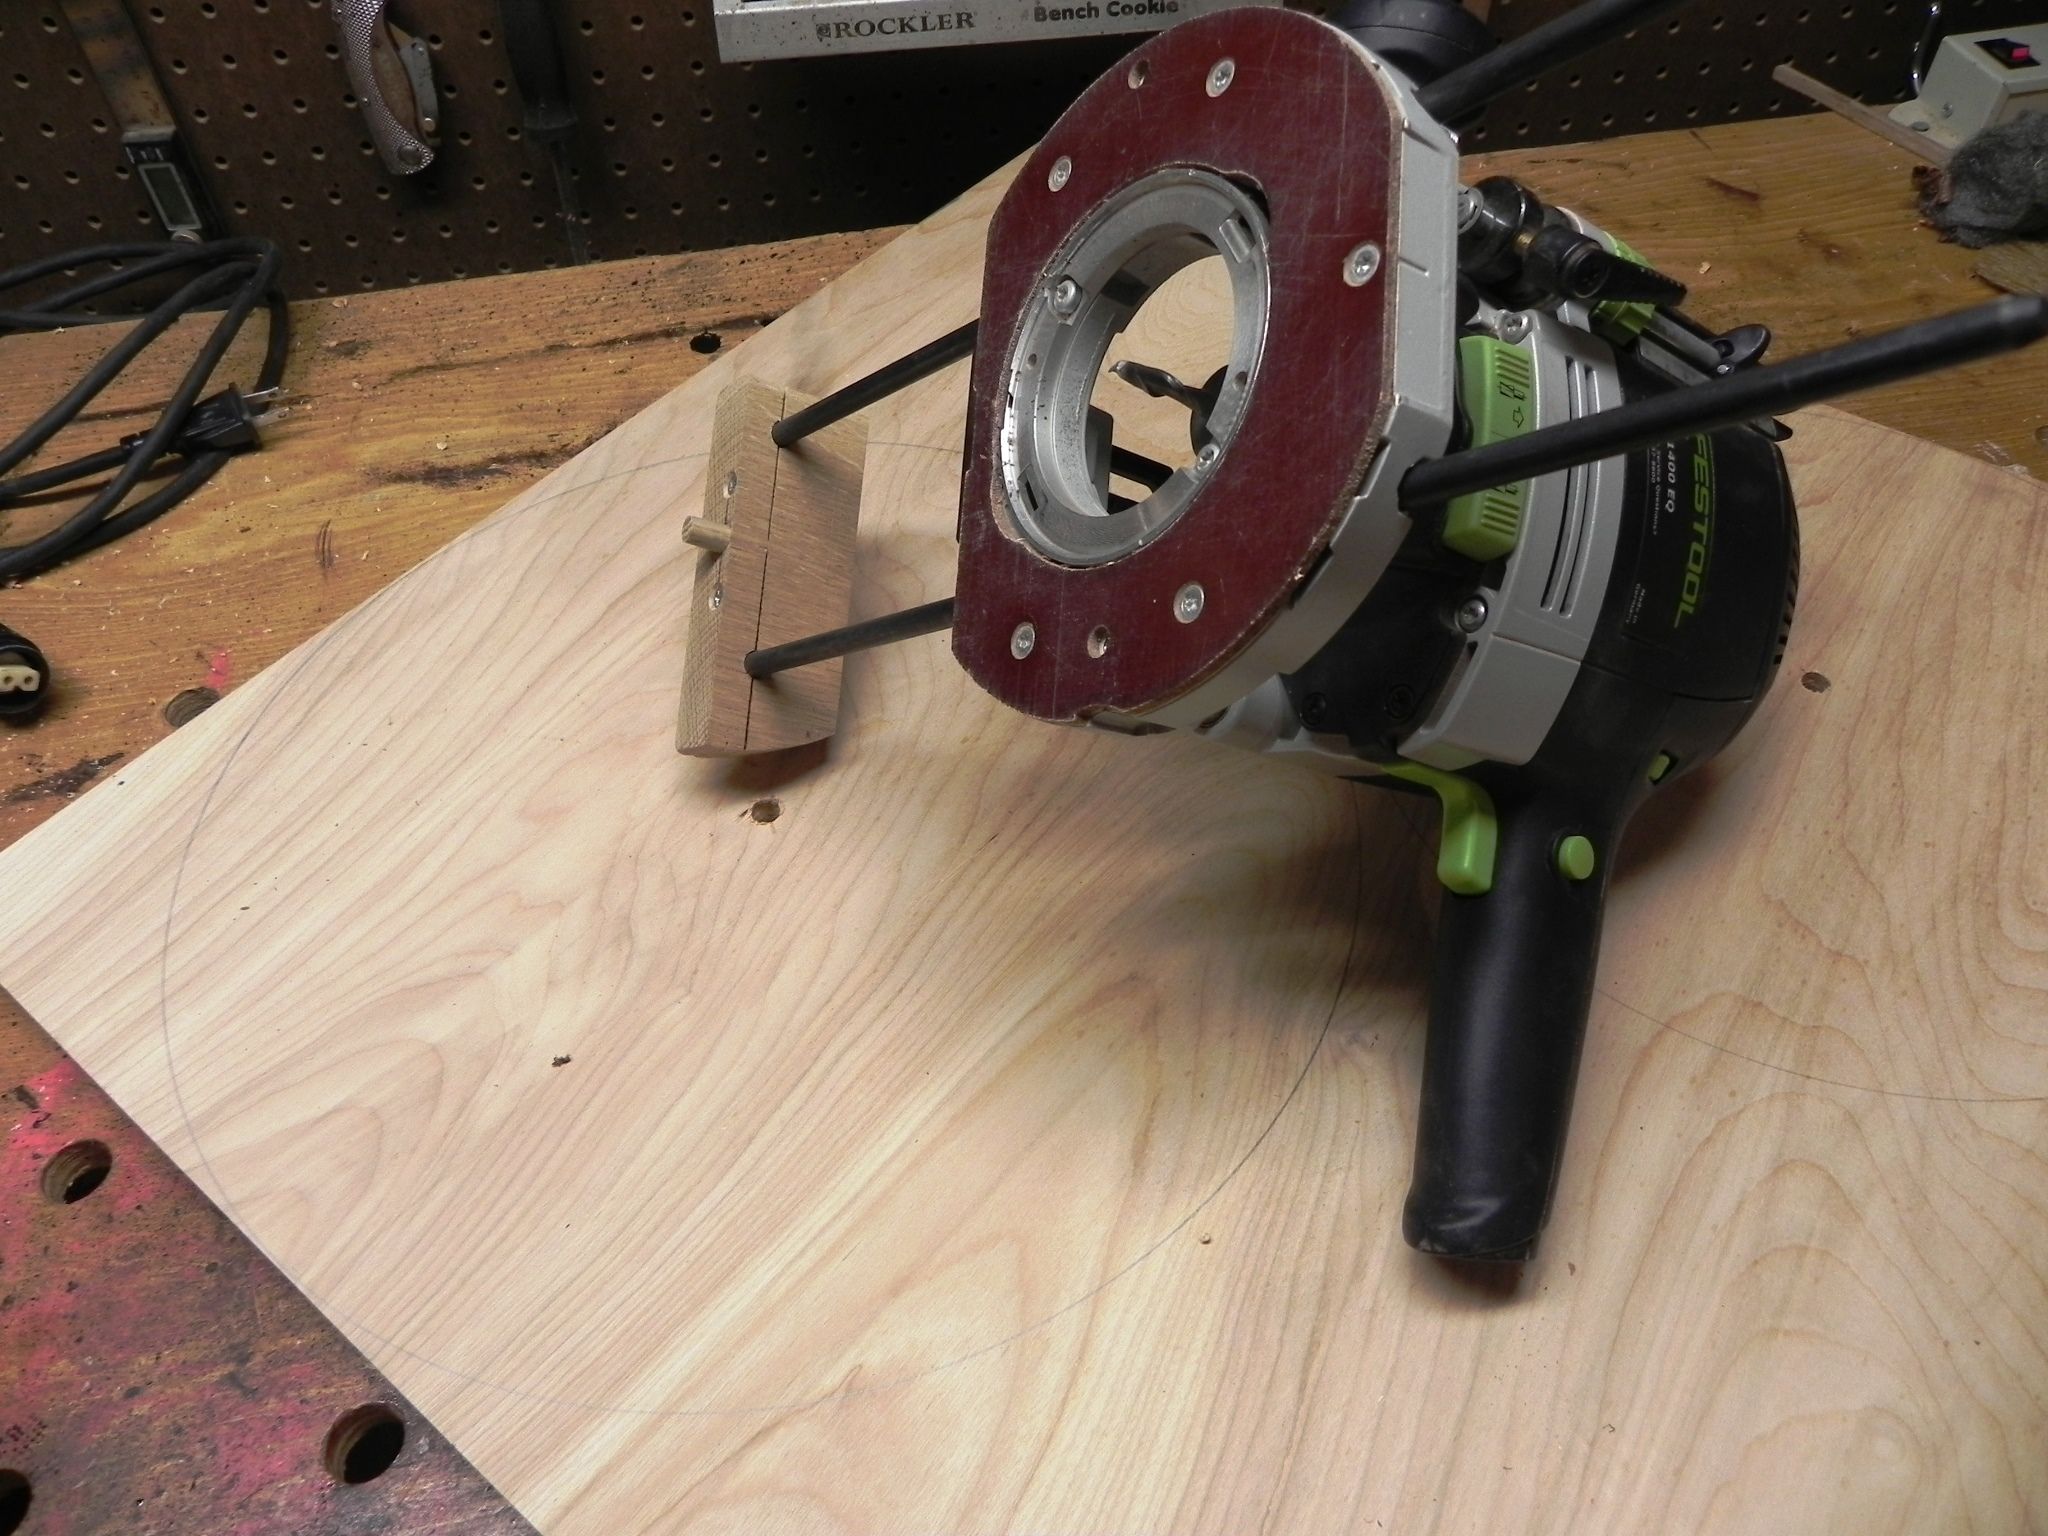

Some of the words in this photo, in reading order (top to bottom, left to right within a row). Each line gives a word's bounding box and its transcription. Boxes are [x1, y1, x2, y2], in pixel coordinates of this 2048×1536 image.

[833, 11, 976, 39] ROCKLER
[1033, 1, 1099, 23] Bench
[1106, 0, 1180, 17] Cookie
[1666, 441, 1676, 484] 1400
[1664, 488, 1676, 513] EQ
[1673, 433, 1709, 629] FESTOOL
